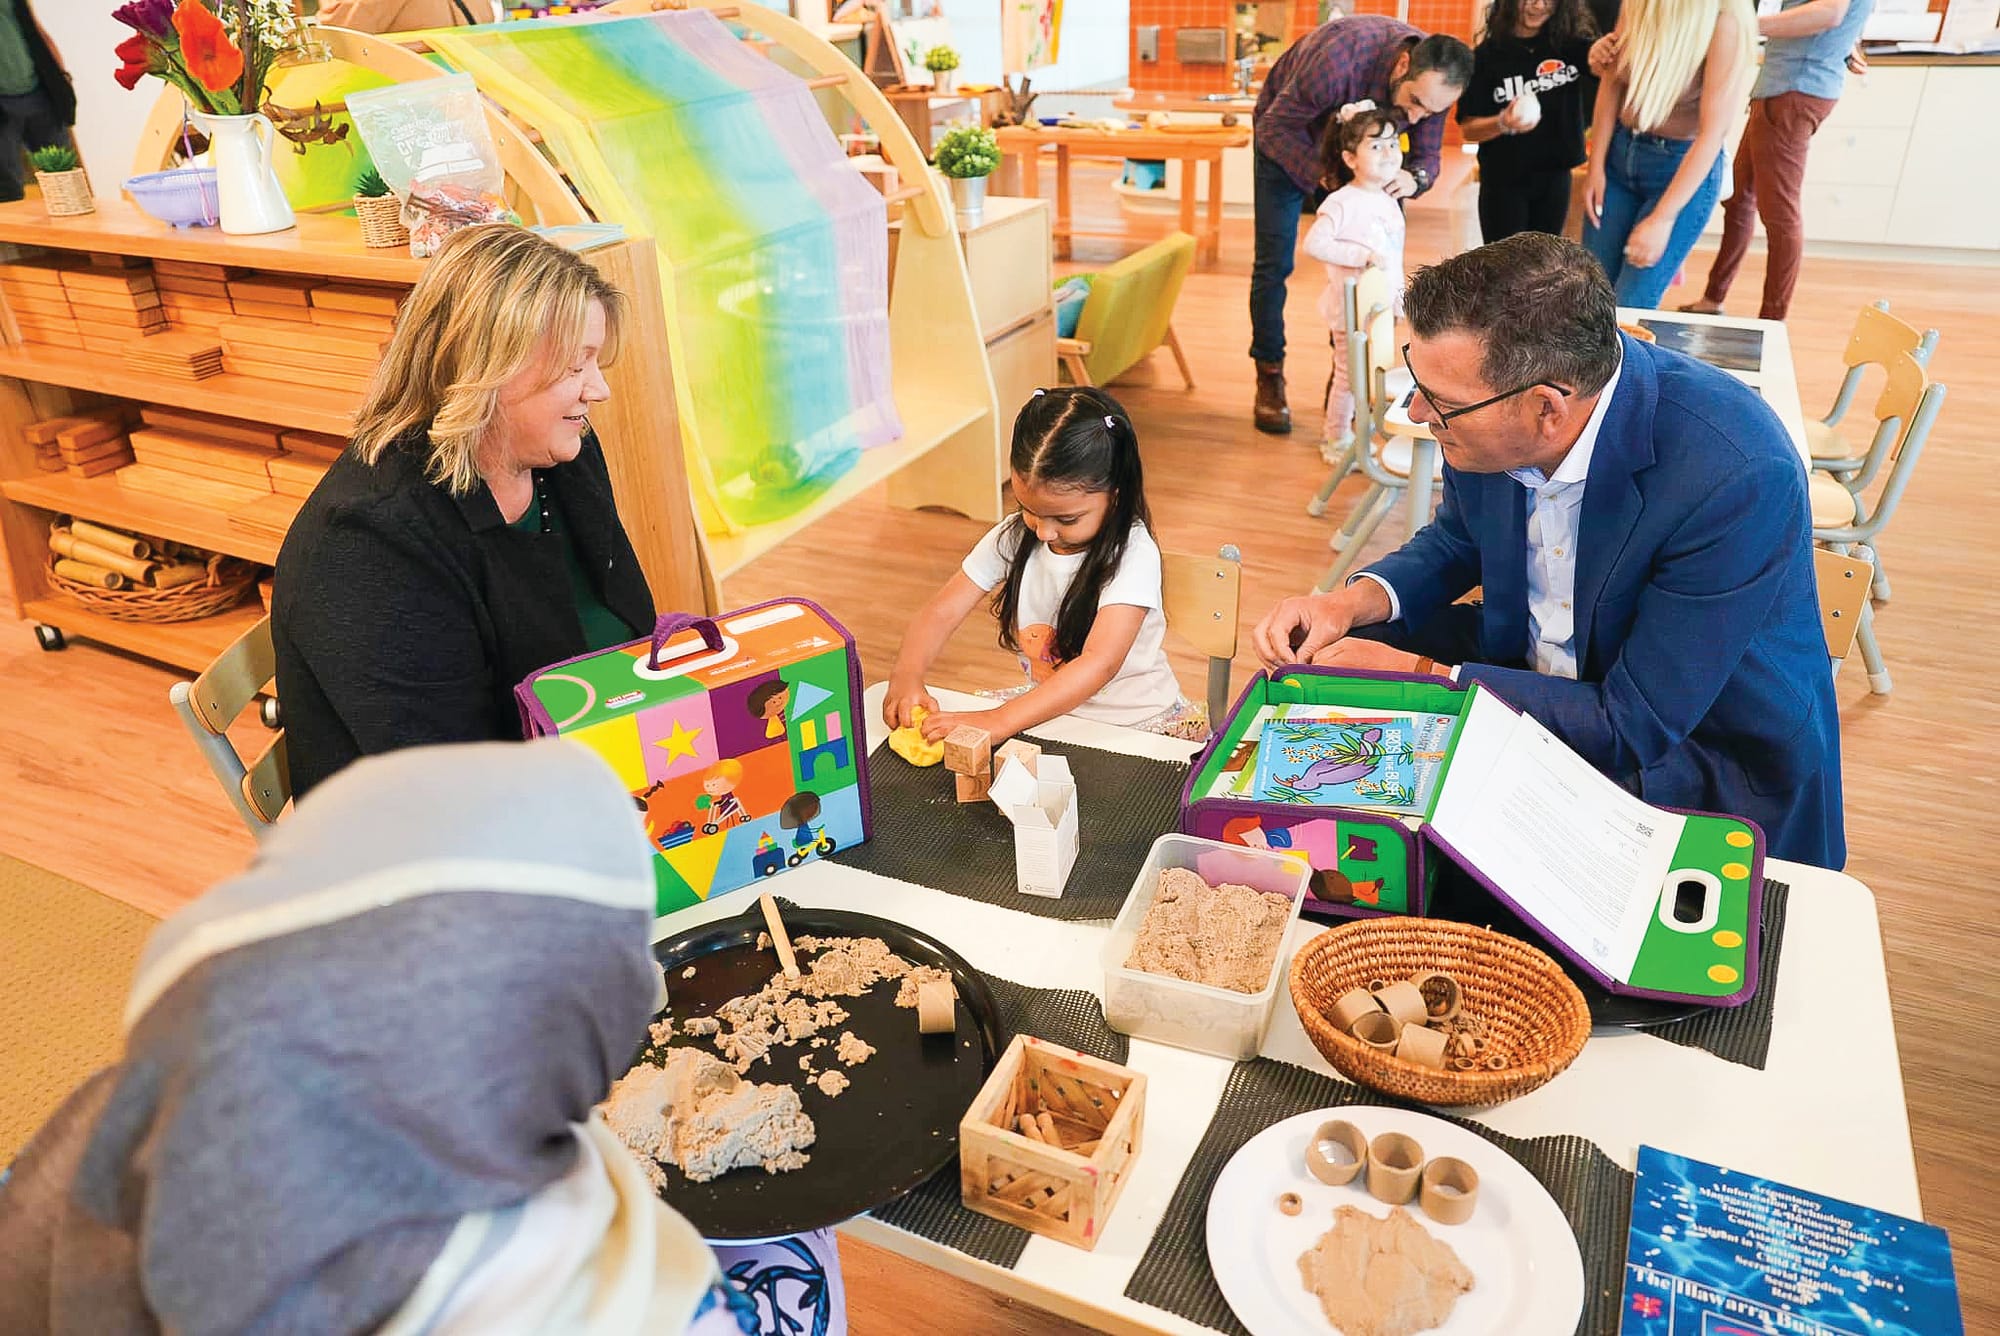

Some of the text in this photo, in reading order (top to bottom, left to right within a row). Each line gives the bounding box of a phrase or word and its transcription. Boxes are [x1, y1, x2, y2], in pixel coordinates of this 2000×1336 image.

[1493, 64, 1580, 103] ellesse
[1384, 771, 1400, 797] BUSH
[1699, 1187, 1769, 1214] Management
[1836, 1226, 1880, 1246] Studies
[1722, 1184, 1853, 1230] Information Technology
[1722, 1203, 1855, 1250] Tourism and Hospitality
[1727, 1214, 1848, 1258] Commercial Cookery
[1780, 1240, 1829, 1262] Cookery
[1735, 1254, 1798, 1281] Secretarial
[1756, 1251, 1820, 1278] Child Care
[1803, 1257, 1827, 1271] and
[1632, 1266, 1671, 1290] The
[1677, 1279, 1771, 1323] Illawarra
